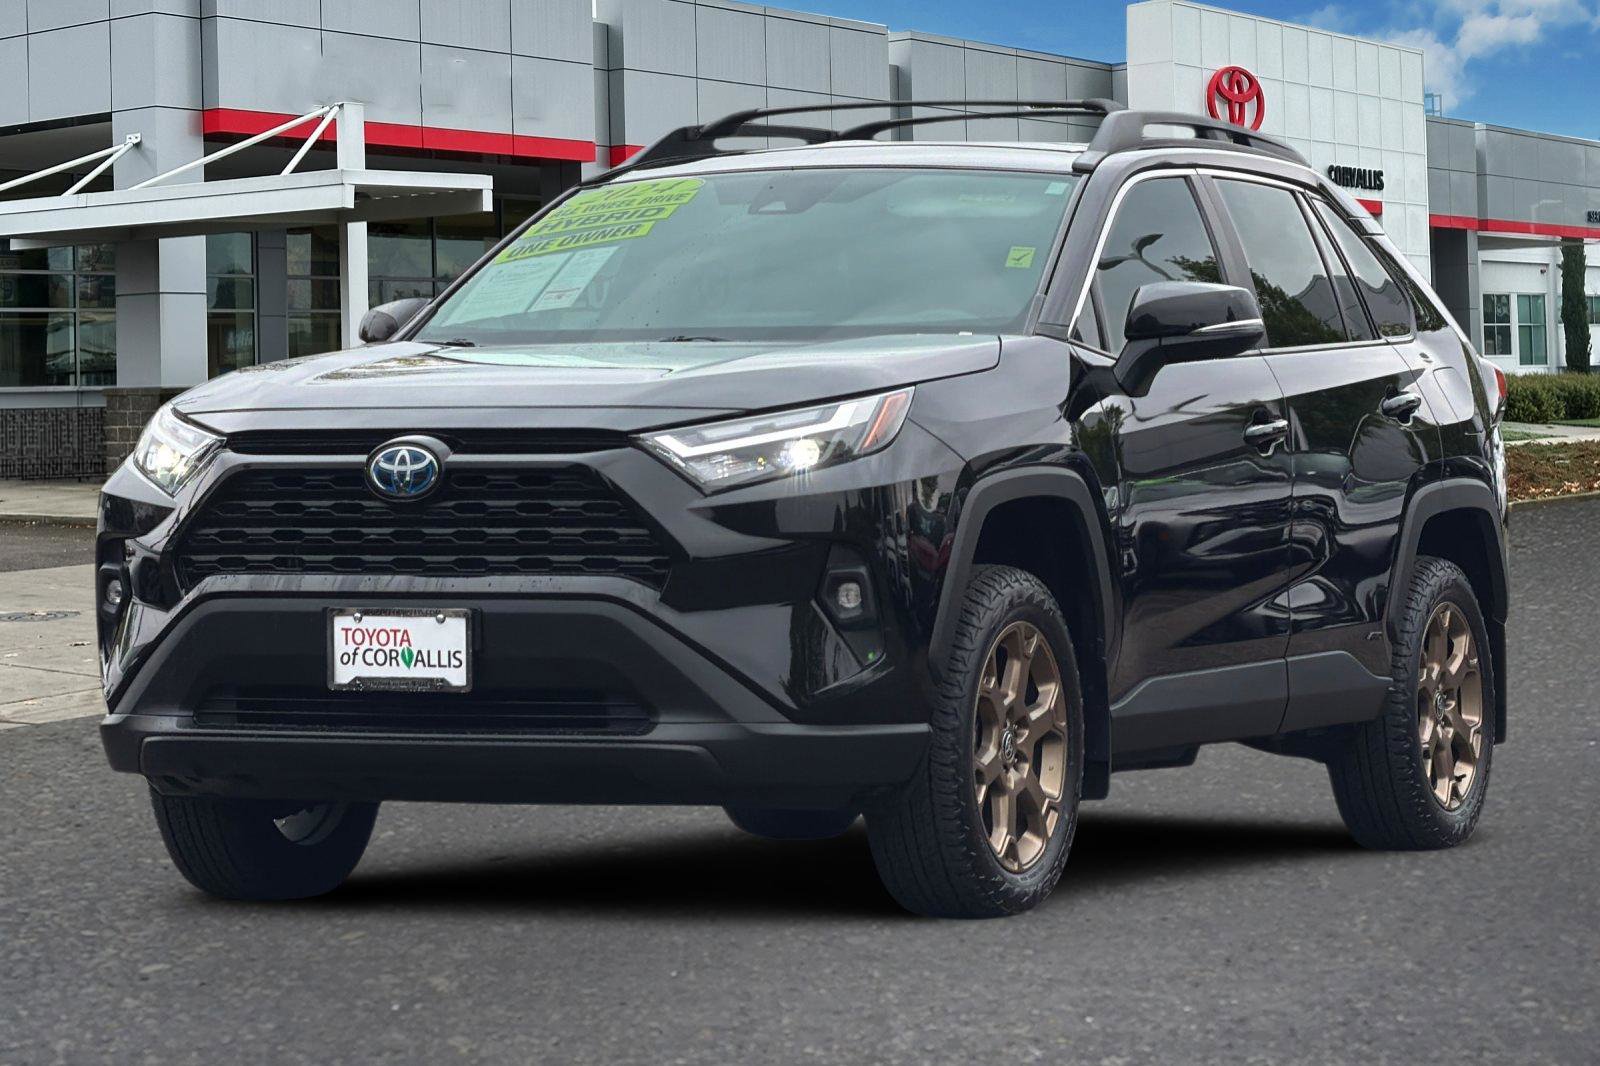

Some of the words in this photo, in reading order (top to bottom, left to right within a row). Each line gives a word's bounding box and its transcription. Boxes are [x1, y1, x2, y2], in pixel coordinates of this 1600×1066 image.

[1327, 164, 1384, 191] CORVALLIS
[636, 191, 691, 206] DRIVE
[534, 206, 666, 235] HYBRID
[506, 239, 554, 258] ONE
[556, 223, 643, 247] OWNER
[340, 627, 412, 647] TOYOTA
[340, 647, 360, 666] of
